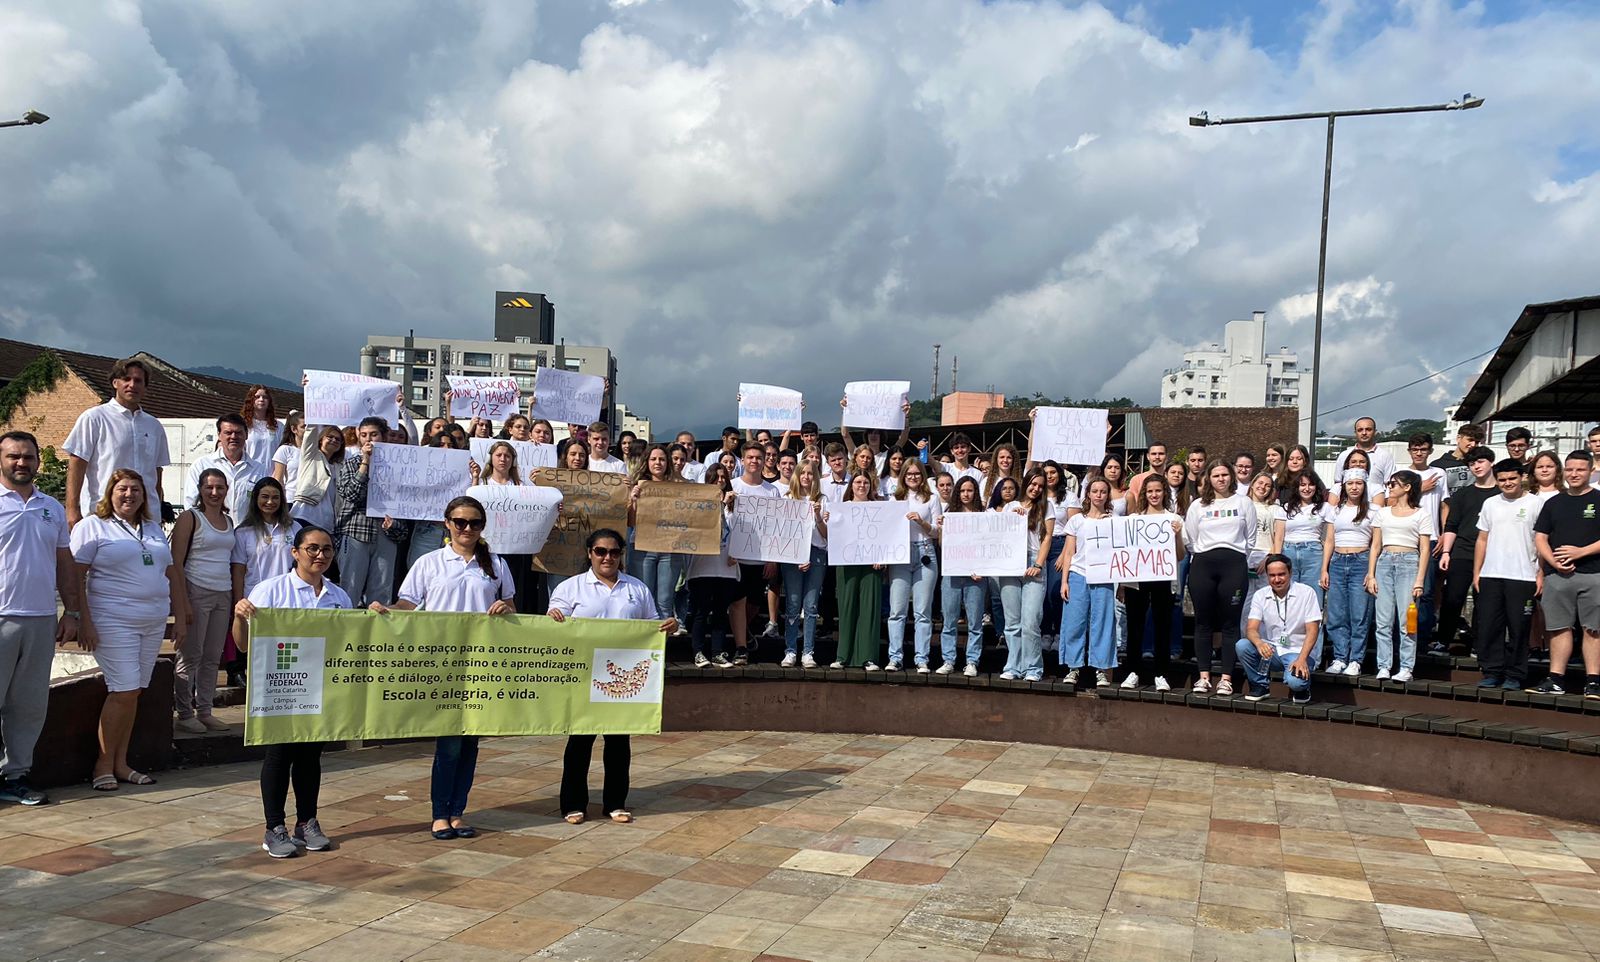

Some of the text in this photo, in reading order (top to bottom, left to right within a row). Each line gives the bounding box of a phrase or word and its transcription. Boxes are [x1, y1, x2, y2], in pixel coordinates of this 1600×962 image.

[454, 388, 481, 401] NUNCA
[471, 400, 502, 417] PAZ
[851, 505, 883, 525] PAZ
[733, 514, 804, 539] ALIMENTA
[1110, 518, 1170, 549] LIVROS
[743, 534, 754, 553] A
[842, 543, 907, 563] CAMINHO
[1110, 548, 1174, 580] ARMAS
[345, 643, 354, 652] A
[357, 643, 394, 653] escola
[398, 643, 405, 653] é
[408, 645, 415, 653] o
[418, 645, 457, 654] espaço
[460, 646, 485, 655] para
[498, 645, 559, 656] construção
[562, 647, 575, 655] de
[325, 658, 387, 668] diferentes
[391, 658, 439, 669] saberes,
[442, 658, 449, 668] é
[452, 658, 489, 668] ensino
[501, 659, 508, 668] é
[510, 660, 589, 672] aprendizagem,
[266, 672, 308, 681] INSTITUTO
[269, 679, 304, 687] FEDERAL
[332, 674, 339, 684] é
[343, 673, 374, 683] afeto
[378, 675, 385, 683] e
[388, 673, 395, 683] é
[398, 672, 443, 685] diálogo,
[446, 672, 453, 682] é
[456, 673, 502, 684] respeito
[514, 674, 581, 685] colaboração.
[383, 688, 540, 702] Escola é alegria, é vida.
[464, 703, 484, 711] 1993)
